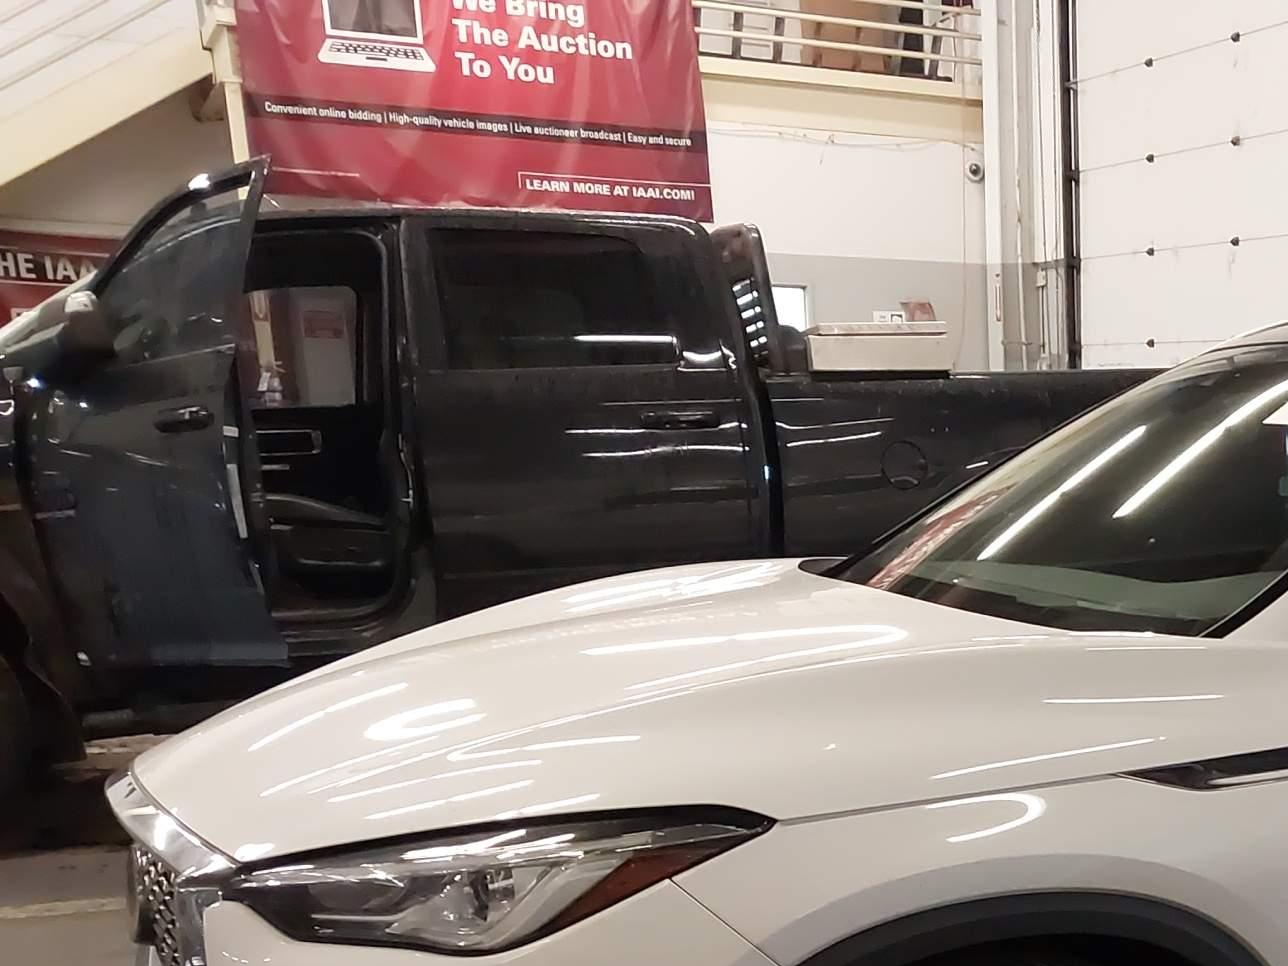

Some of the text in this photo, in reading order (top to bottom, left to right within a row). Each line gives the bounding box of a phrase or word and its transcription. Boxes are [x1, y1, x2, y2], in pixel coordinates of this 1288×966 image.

[505, 0, 585, 28] Bring
[451, 18, 634, 59] The Auction
[454, 51, 555, 84] To You
[264, 101, 318, 116] Convenient
[319, 108, 347, 118] online
[348, 109, 383, 123] bidding
[388, 111, 441, 128] High-quality
[443, 118, 475, 129] vehicle
[476, 120, 509, 132] images
[514, 123, 532, 134] Live
[533, 126, 579, 138] auctioneer
[580, 128, 622, 142] broadcast
[627, 132, 648, 145] Easy
[648, 136, 664, 145] and
[664, 137, 692, 146] secure
[525, 178, 570, 193] LEARN
[573, 181, 612, 196] MORE
[613, 185, 629, 196] AT
